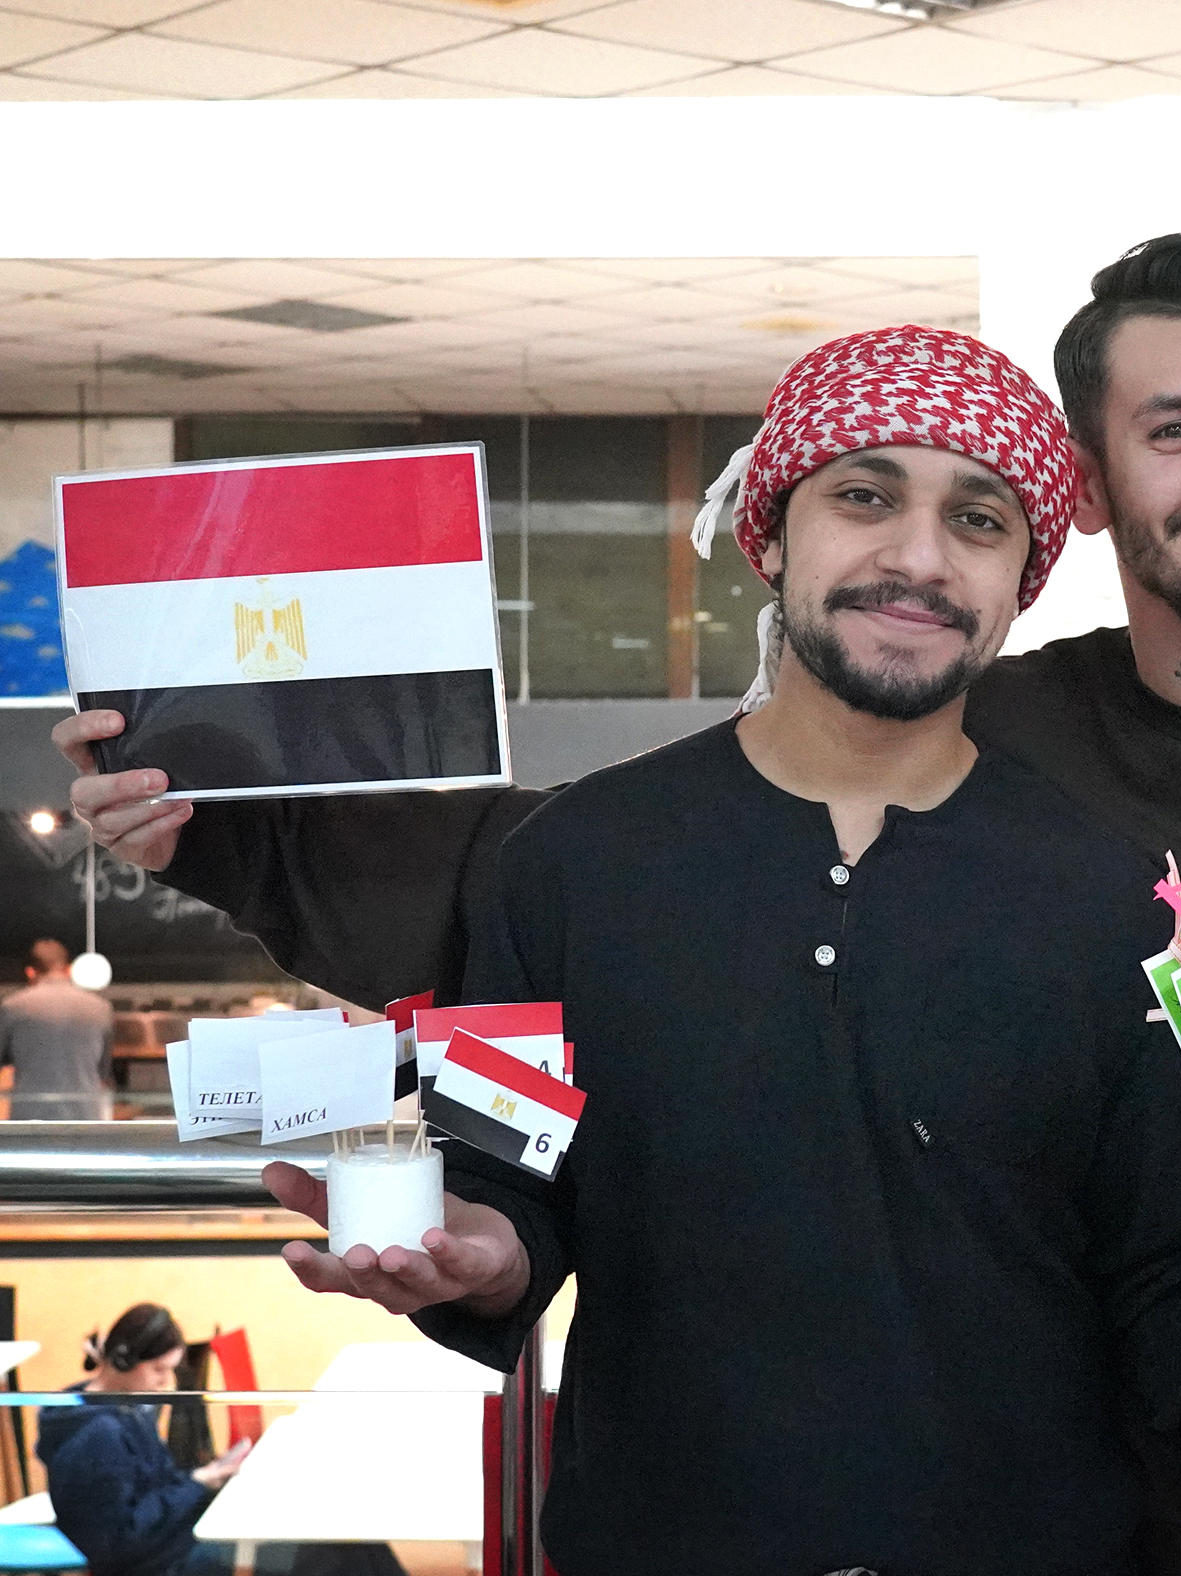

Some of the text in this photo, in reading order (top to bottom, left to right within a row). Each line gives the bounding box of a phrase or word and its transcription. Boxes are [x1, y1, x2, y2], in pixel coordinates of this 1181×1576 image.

[271, 1107, 327, 1133] ХАМСА
[913, 1119, 931, 1143] ZARA
[535, 1133, 552, 1153] 6
